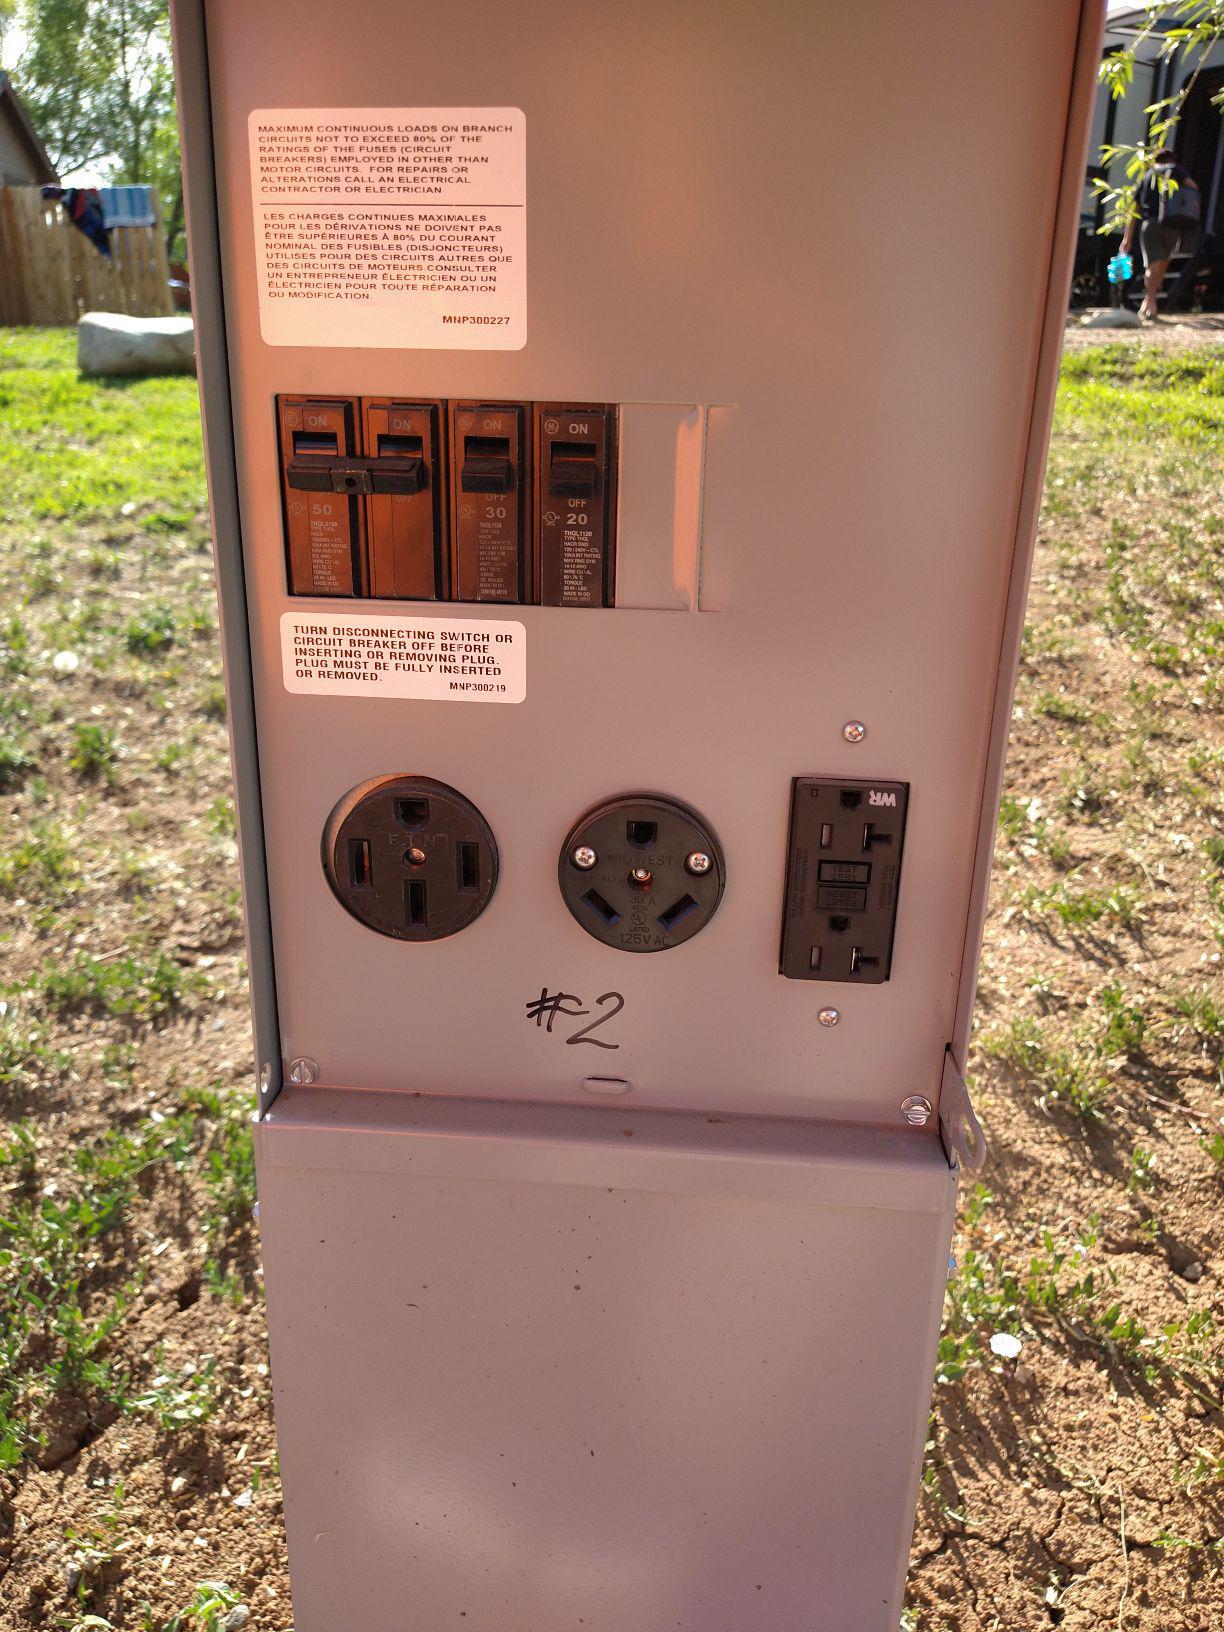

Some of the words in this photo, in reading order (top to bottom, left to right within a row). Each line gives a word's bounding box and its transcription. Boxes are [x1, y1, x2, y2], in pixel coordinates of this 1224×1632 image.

[325, 222, 401, 231] DÉRIVATIONS
[382, 273, 456, 282] ÉLECTRICIEN
[268, 281, 342, 289] ÉLECTRICIEN
[422, 283, 495, 292] RÉPARATION
[443, 315, 510, 325] MNP300227
[308, 416, 327, 426] ON
[393, 419, 412, 429] ON
[484, 419, 502, 430] ON
[569, 424, 588, 434] ON
[568, 499, 587, 508] OFF
[312, 504, 332, 515] 50
[486, 507, 506, 519] 30
[566, 513, 588, 525] 20
[294, 626, 327, 635] TURN
[334, 627, 434, 640] DISCONNECTING
[440, 631, 490, 642] SWITCH
[496, 634, 513, 644] OR
[294, 637, 342, 647] CIRCUIT
[350, 639, 406, 650] BREAKER
[412, 642, 435, 651] OFF
[441, 643, 489, 653] BEFORE
[295, 648, 362, 659] INSERTING
[367, 651, 384, 659] OR
[390, 652, 456, 663] REMOVING
[462, 655, 500, 664] PLUG.
[296, 659, 328, 668] PLUG
[334, 660, 369, 670] MUST
[375, 662, 389, 671] BE
[395, 663, 434, 673] FULLY
[440, 665, 501, 676] INSERTED
[296, 670, 312, 678] OR
[318, 671, 383, 681] REMOVED.
[450, 682, 506, 692] MNP300219
[869, 790, 896, 807] WR
[608, 854, 674, 866] MIDWEST
[655, 936, 670, 945] AC
